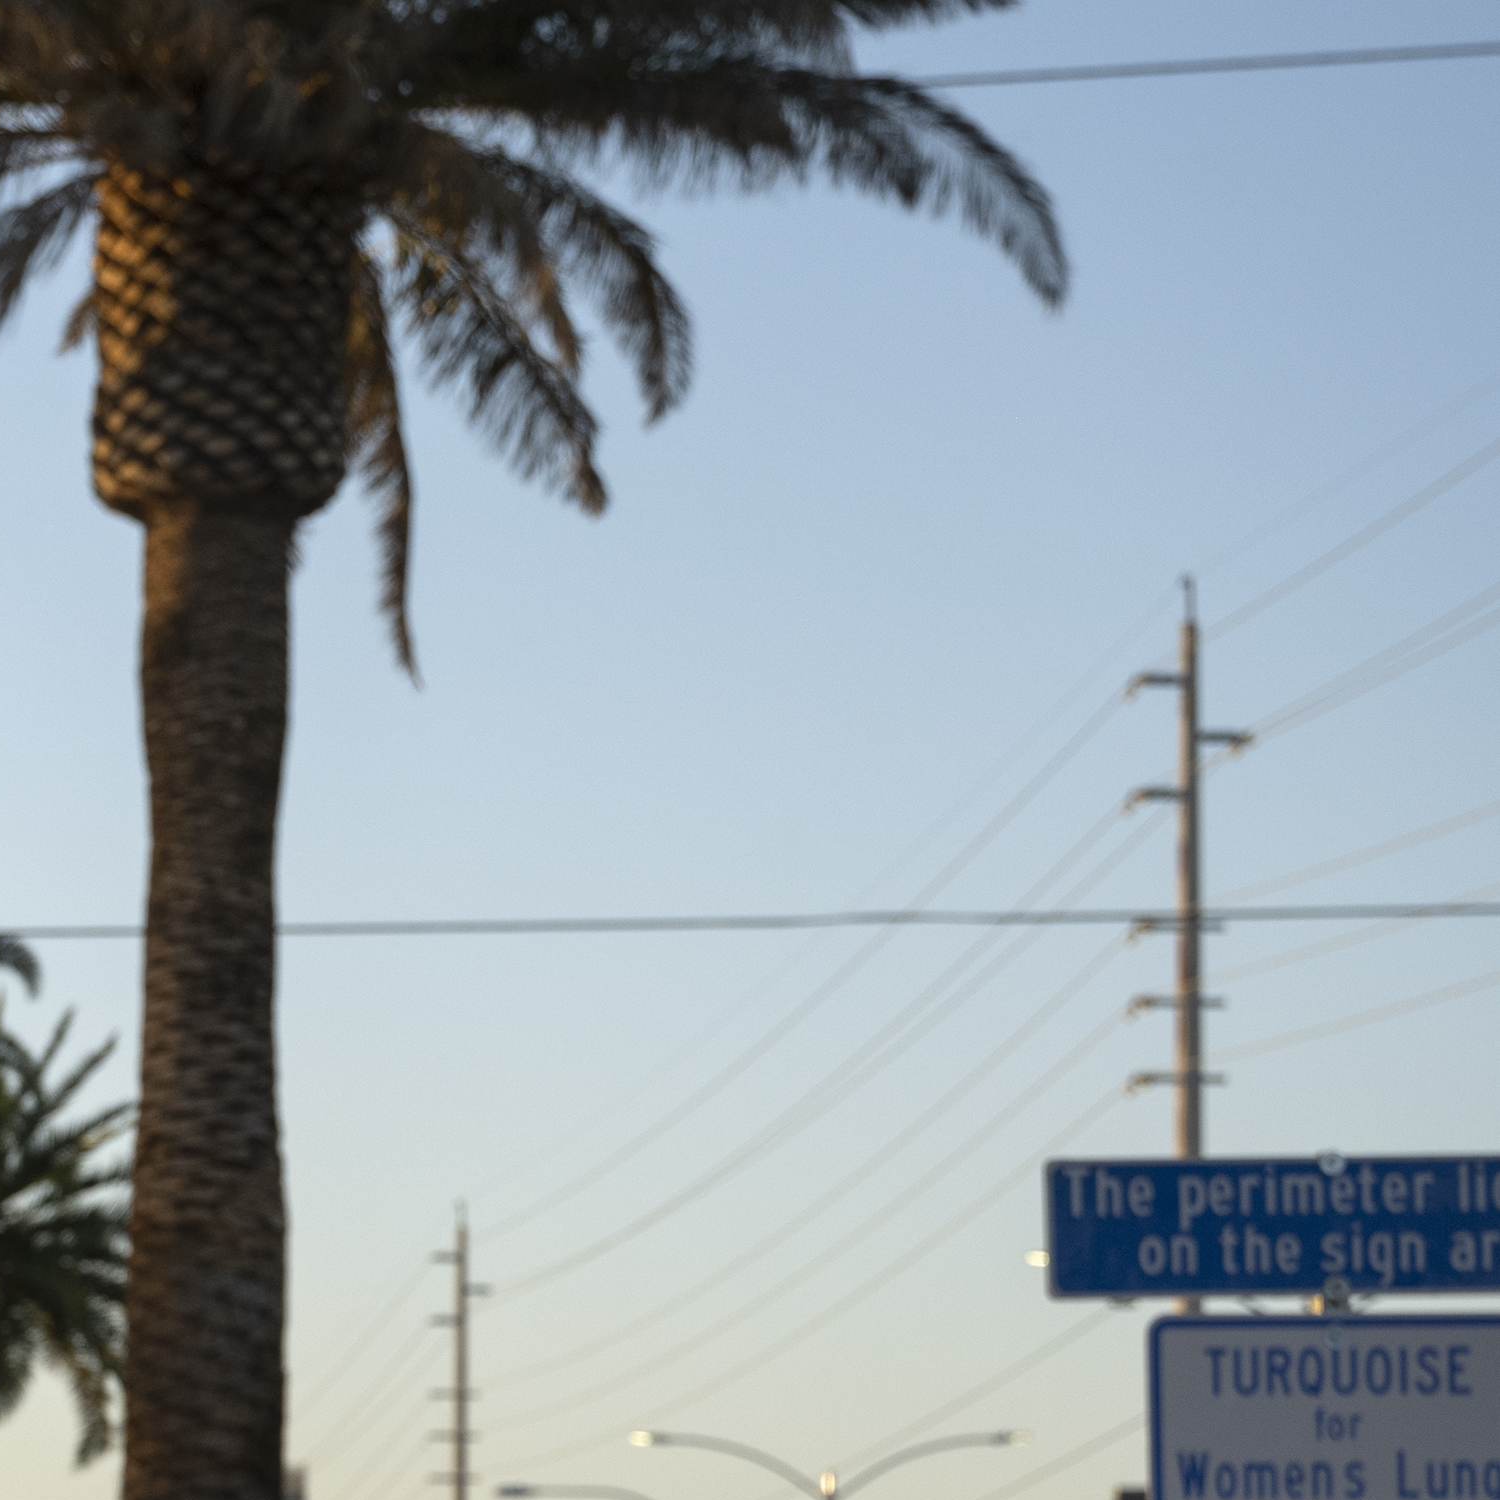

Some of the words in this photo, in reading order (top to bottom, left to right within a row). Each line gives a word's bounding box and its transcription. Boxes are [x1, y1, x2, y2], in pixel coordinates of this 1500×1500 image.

[1062, 1166, 1155, 1218] The
[1177, 1162, 1434, 1231] perimeter
[1137, 1233, 1200, 1277] on
[1218, 1223, 1301, 1275] the
[1319, 1220, 1428, 1290] sign
[1204, 1344, 1474, 1397] TURQUOISE
[1313, 1406, 1364, 1442] for
